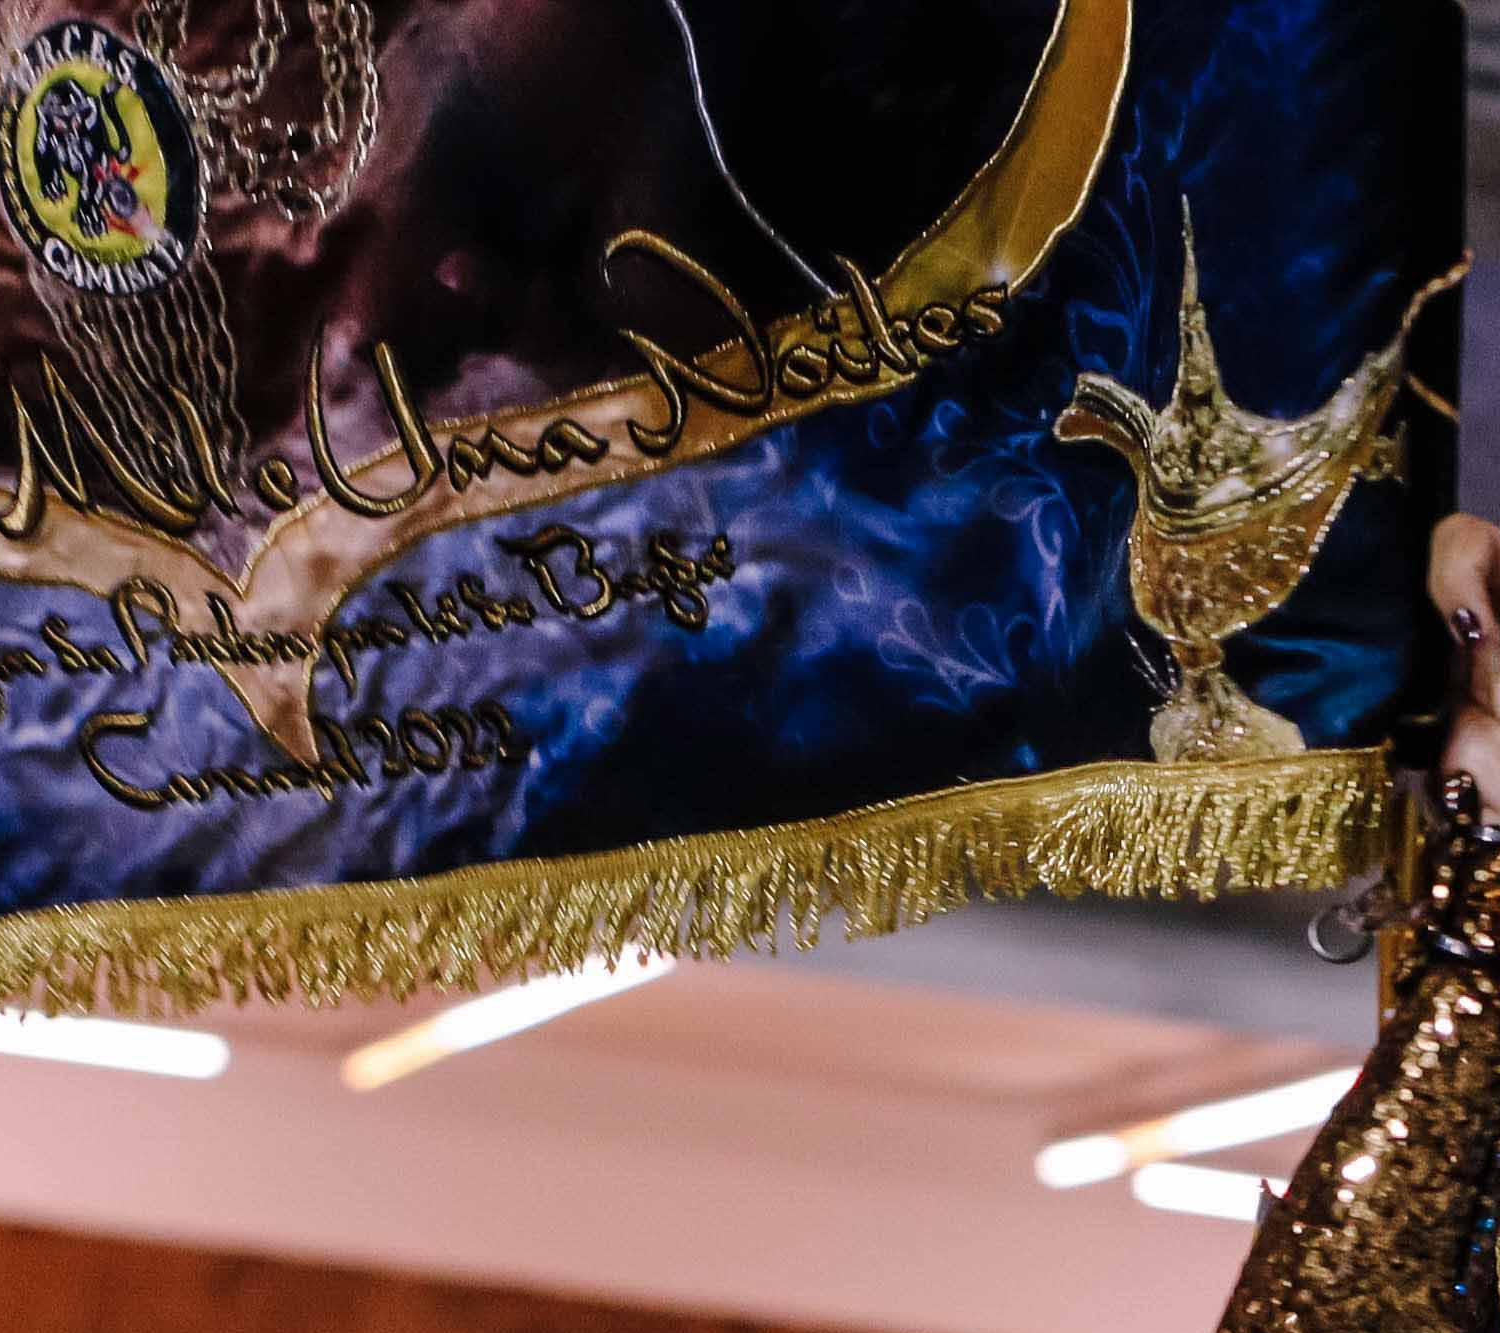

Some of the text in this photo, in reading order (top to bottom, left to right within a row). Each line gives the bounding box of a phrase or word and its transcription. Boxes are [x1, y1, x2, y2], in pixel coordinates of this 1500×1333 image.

[257, 457, 298, 511] e
[303, 335, 609, 516] Uma
[601, 228, 1010, 457] Noites
[78, 700, 532, 812] Carnaval 2022
